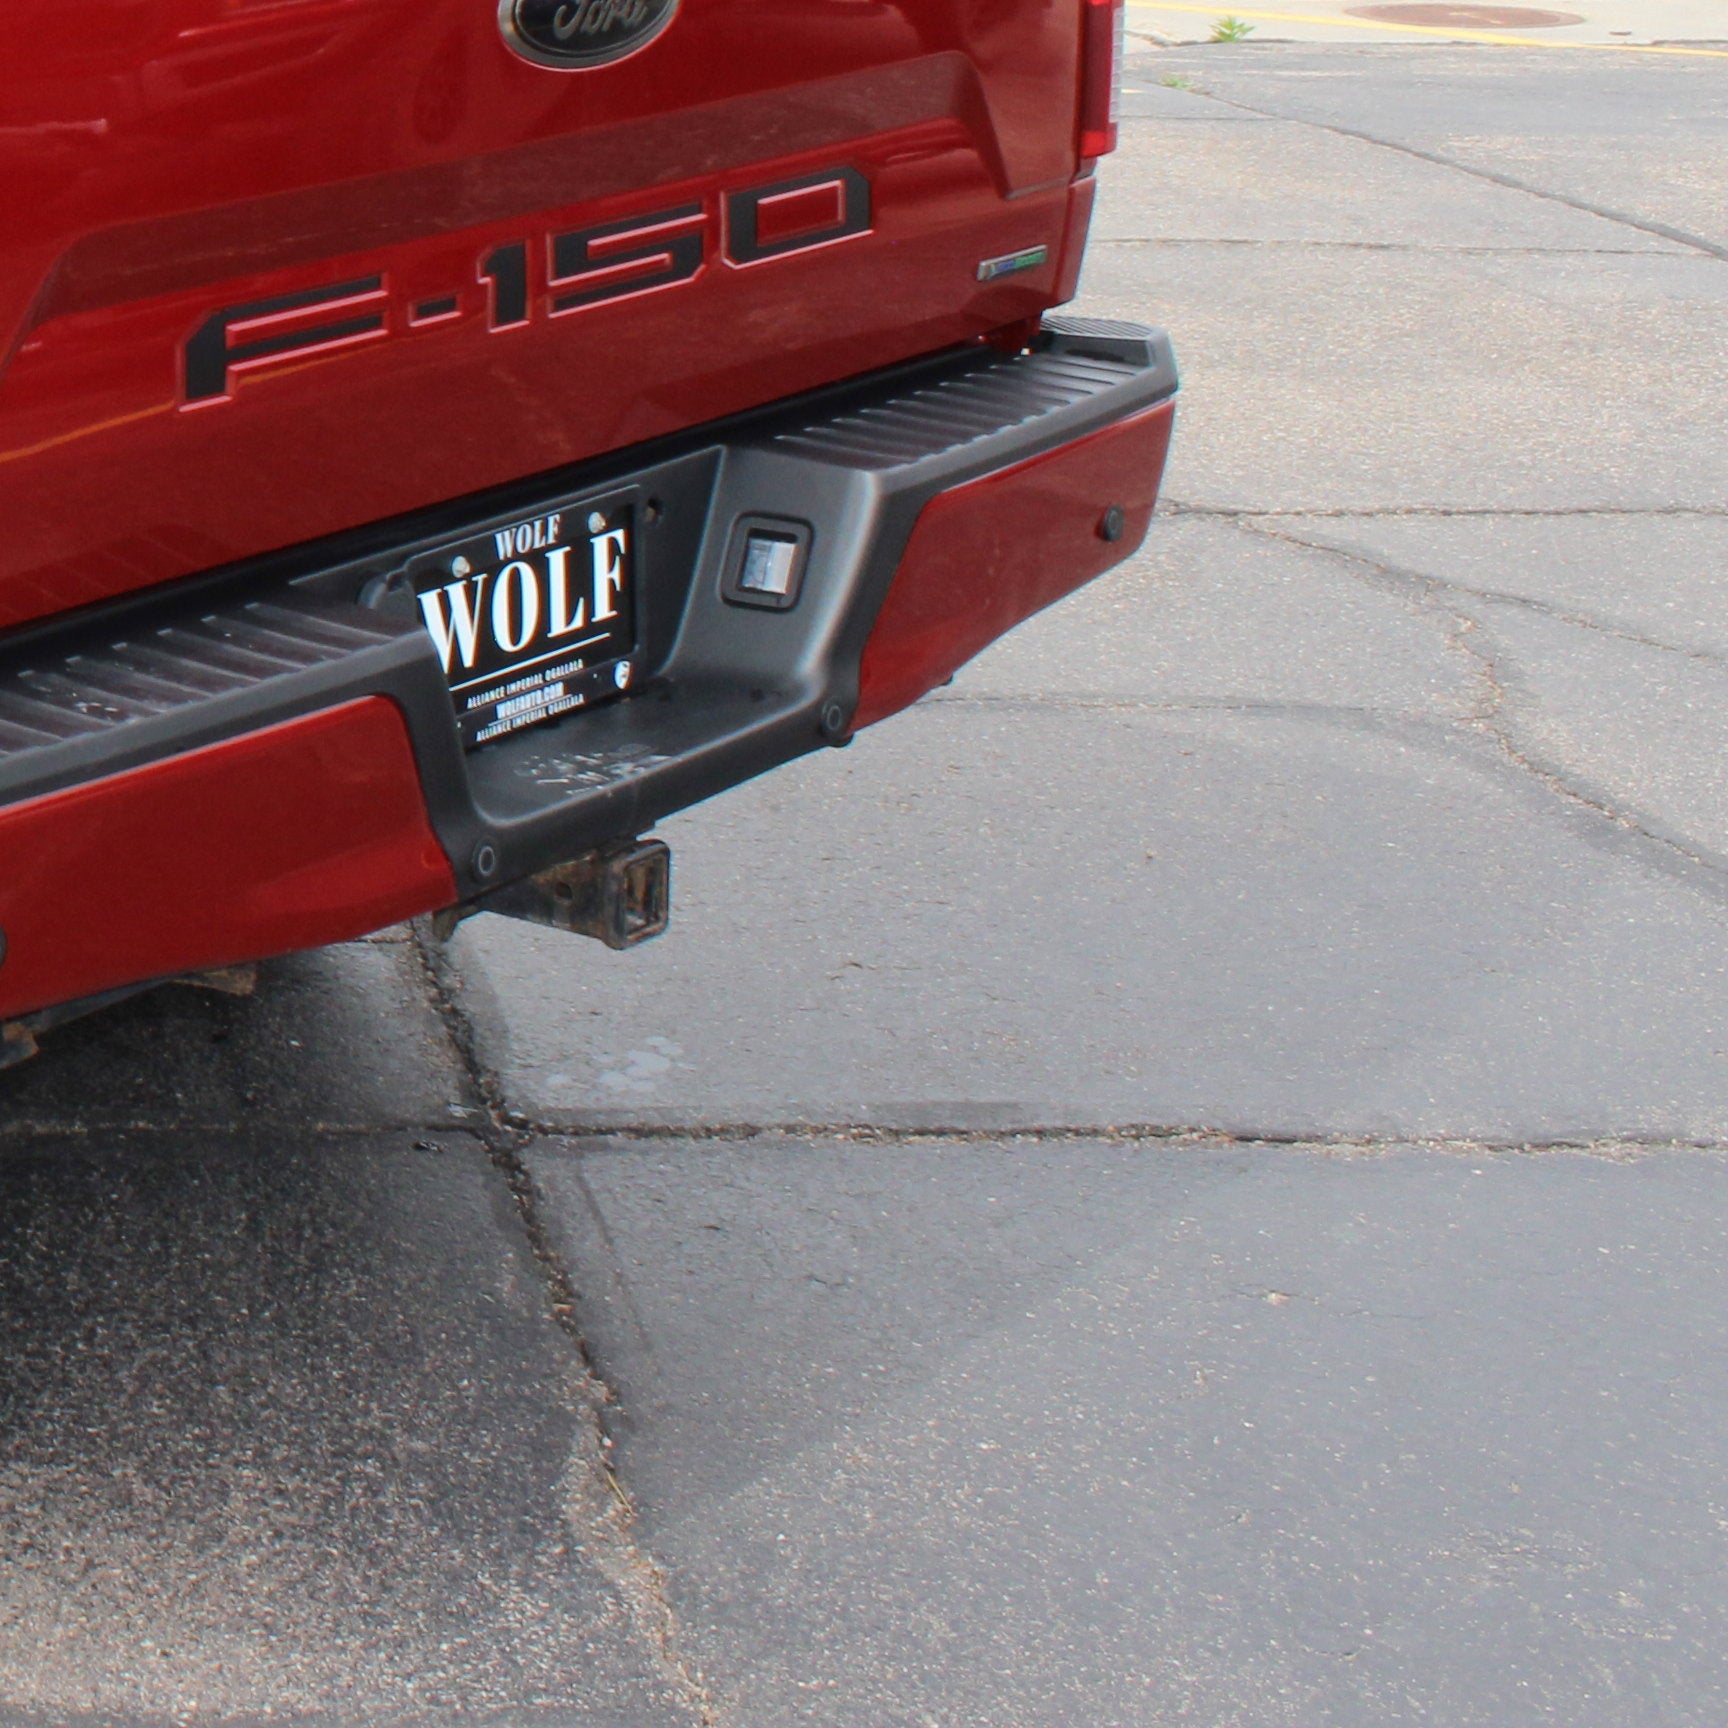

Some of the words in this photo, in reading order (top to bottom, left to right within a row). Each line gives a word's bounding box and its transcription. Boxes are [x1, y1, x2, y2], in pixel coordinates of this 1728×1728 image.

[177, 166, 874, 412] F-150
[494, 513, 561, 561] WOLF
[416, 528, 627, 674] WOLF
[467, 684, 506, 710] ALLIANCE
[506, 672, 544, 696] IMPERIAL
